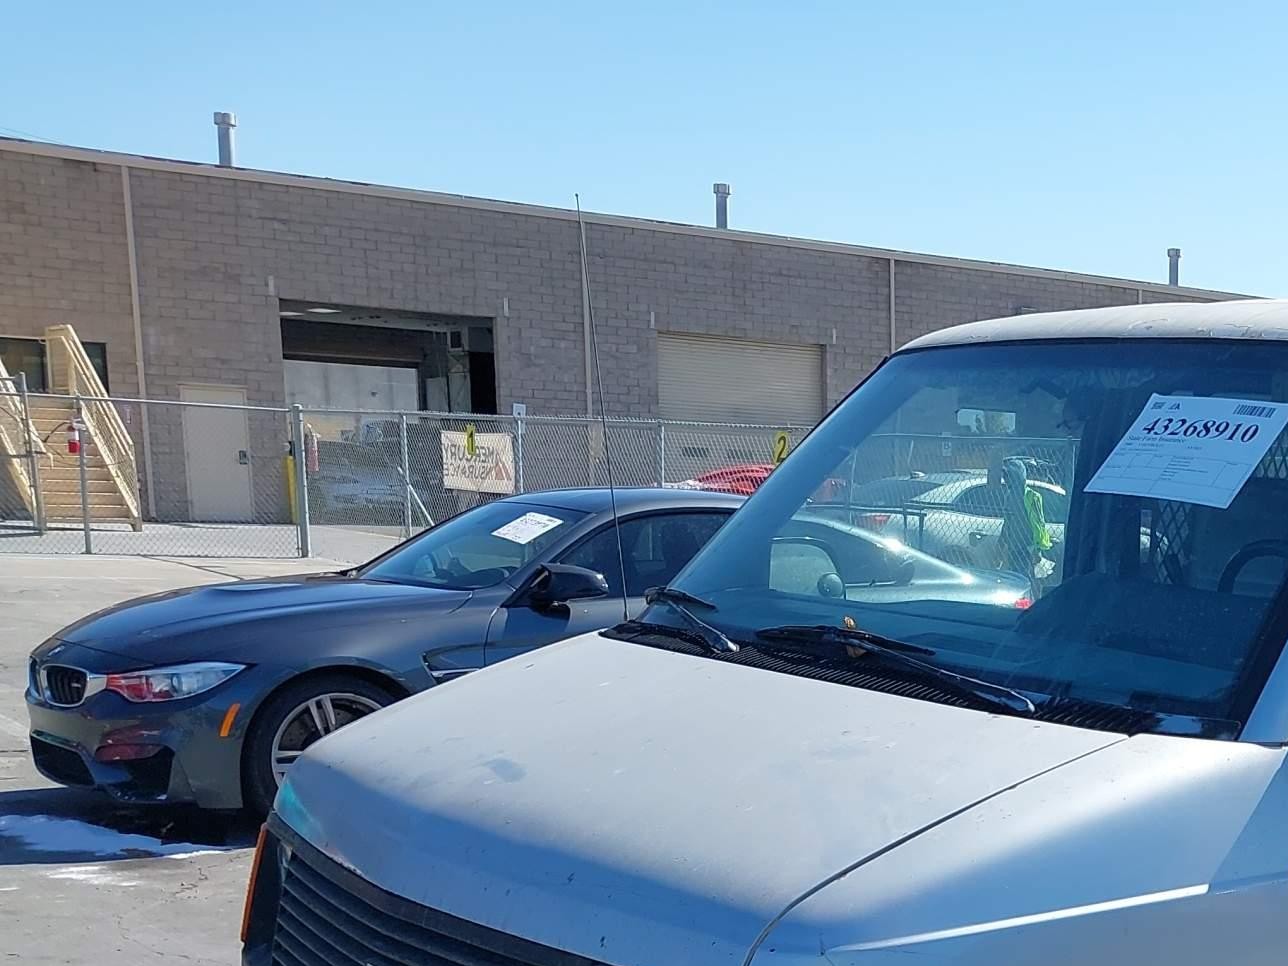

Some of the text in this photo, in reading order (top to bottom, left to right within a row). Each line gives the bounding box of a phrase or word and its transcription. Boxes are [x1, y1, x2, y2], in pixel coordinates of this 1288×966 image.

[468, 430, 474, 453] 1
[1142, 417, 1260, 443] 43268910
[776, 435, 787, 463] 2
